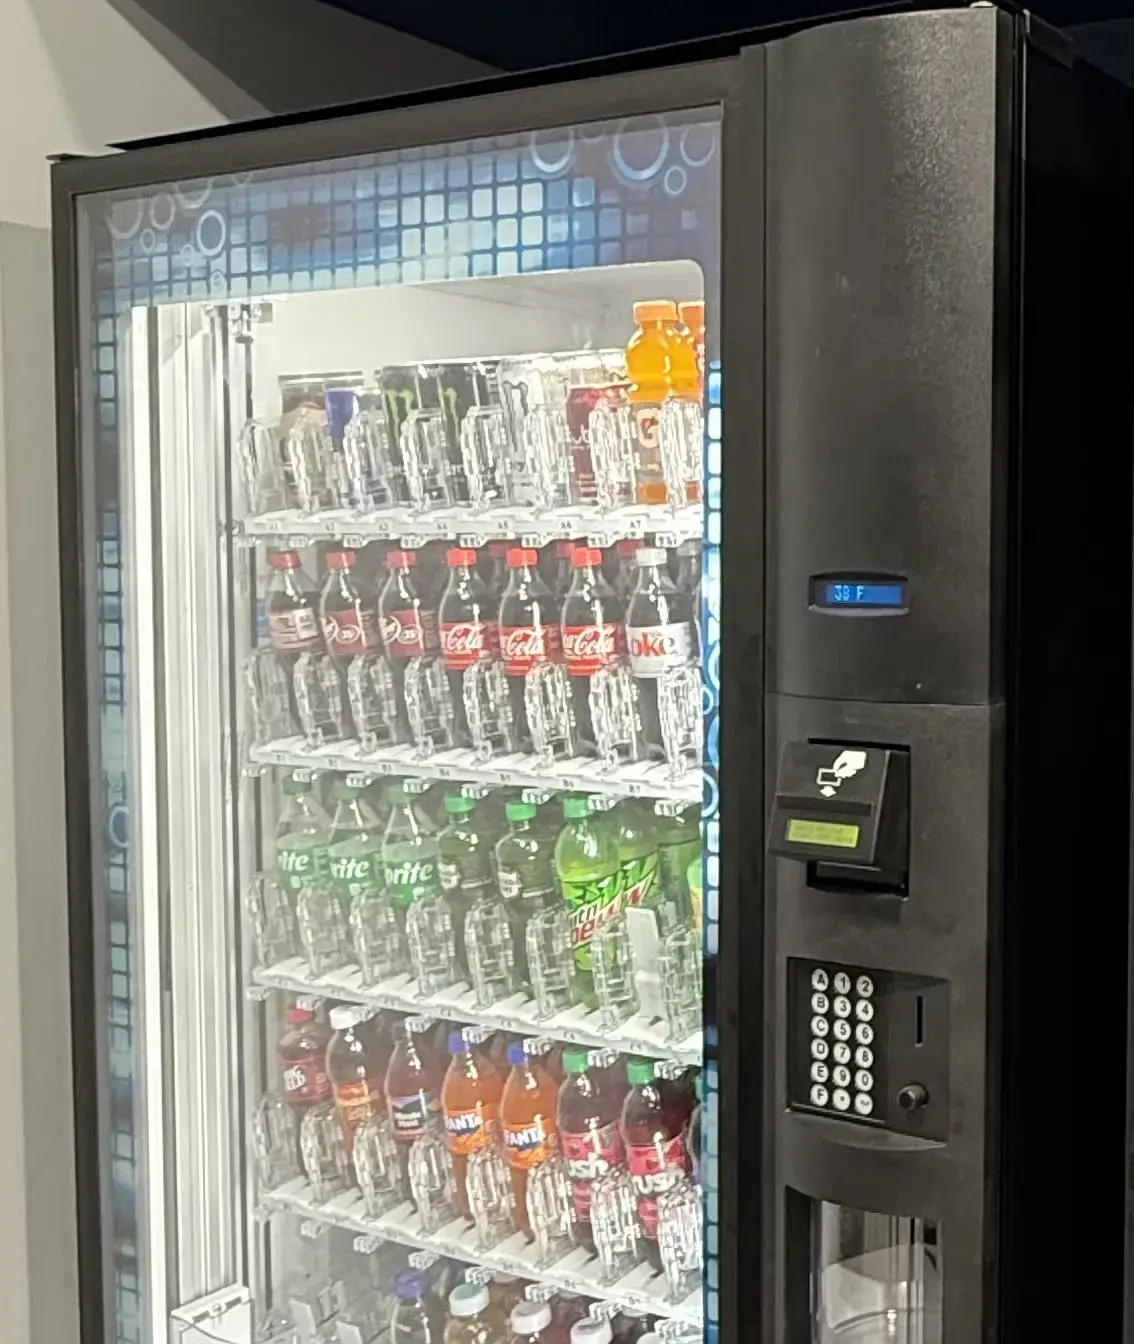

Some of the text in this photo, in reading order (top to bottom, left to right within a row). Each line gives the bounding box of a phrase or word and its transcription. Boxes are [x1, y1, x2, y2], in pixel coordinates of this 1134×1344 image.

[856, 584, 865, 601] F
[816, 973, 826, 986] A
[840, 976, 846, 989] 1
[862, 980, 870, 993] 2
[817, 996, 826, 1008] B
[839, 1000, 847, 1013] 3
[861, 1003, 870, 1016] 4
[816, 1019, 826, 1032] C
[839, 1022, 847, 1036] 5
[861, 1026, 870, 1039] 6
[816, 1042, 825, 1054] D
[839, 1046, 847, 1058] 7
[862, 1049, 869, 1062] 8
[816, 1065, 825, 1077] E
[839, 1069, 847, 1082] 9
[861, 1073, 869, 1086] 0
[816, 1088, 825, 1100] F
